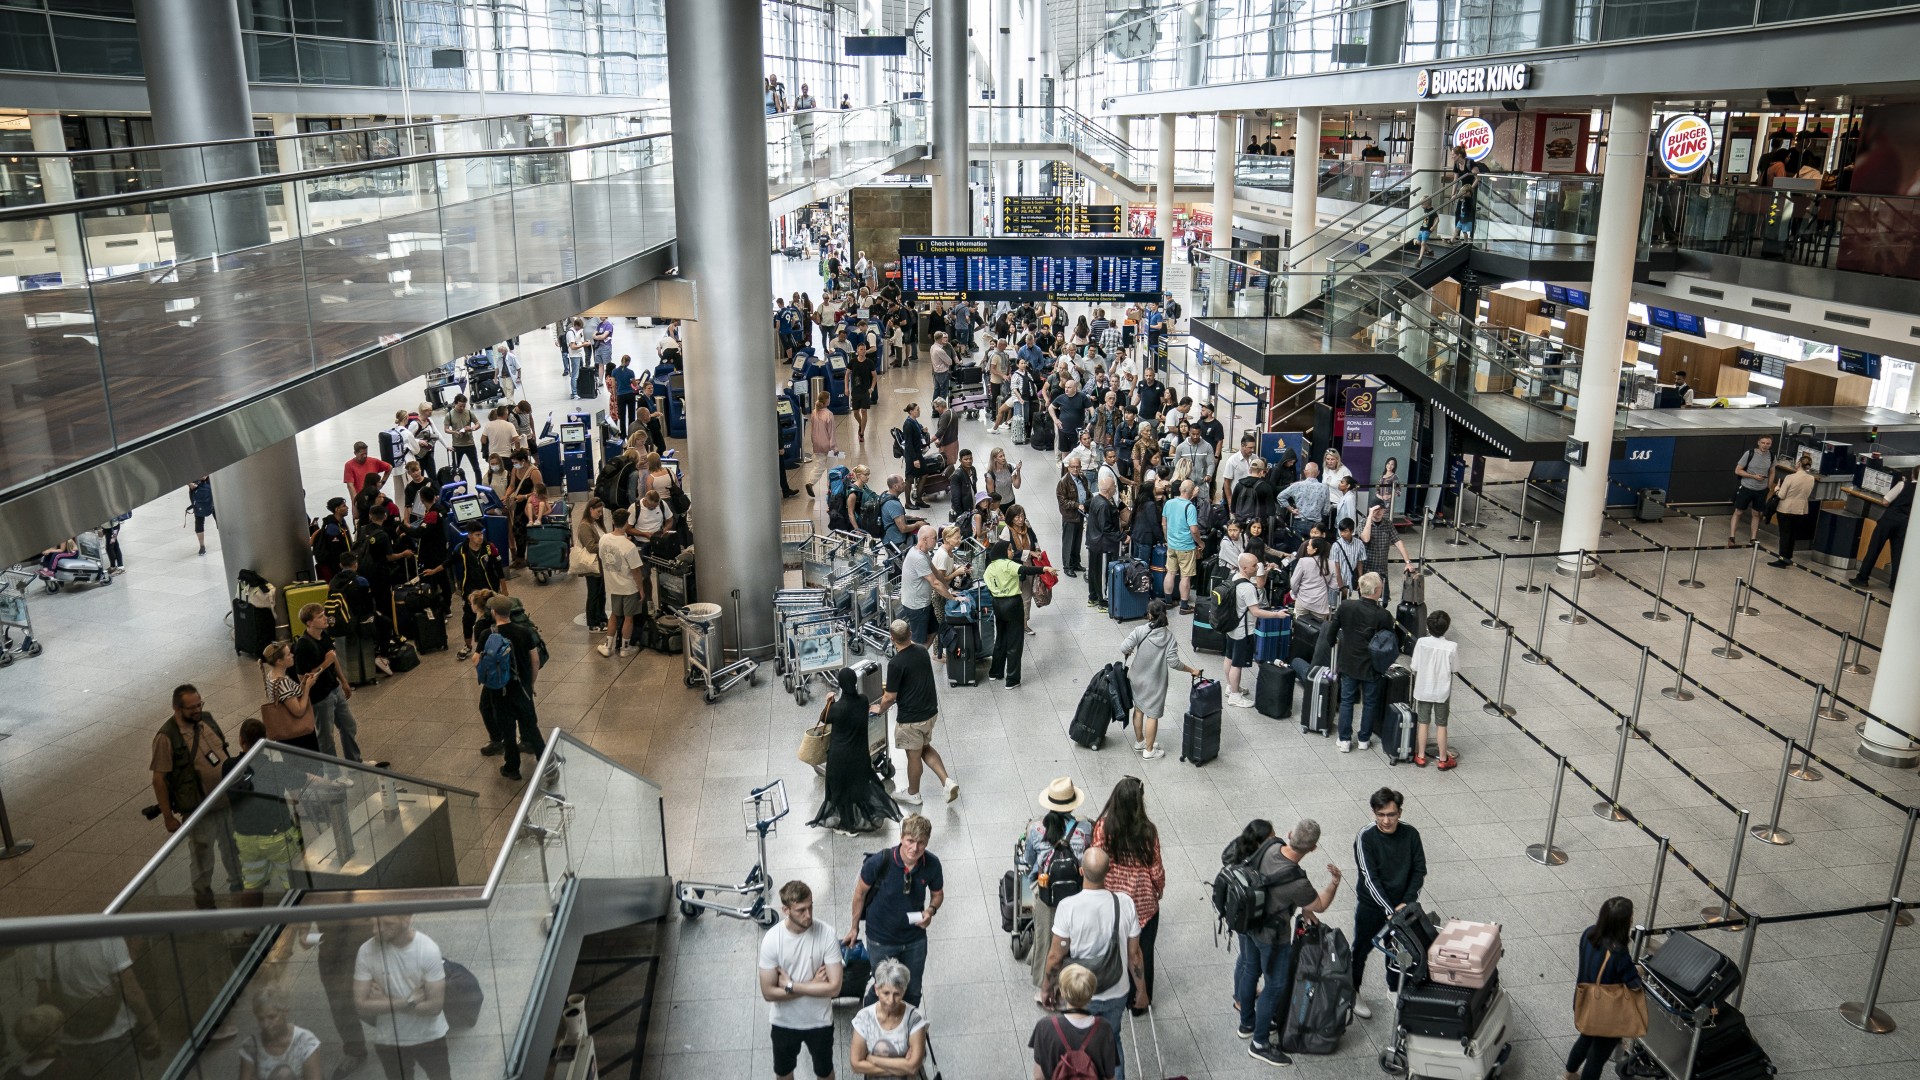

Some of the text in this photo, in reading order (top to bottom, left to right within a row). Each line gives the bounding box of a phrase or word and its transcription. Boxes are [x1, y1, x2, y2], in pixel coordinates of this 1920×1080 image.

[1432, 63, 1526, 94] BURGER KING
[1458, 126, 1489, 141] BURGER
[1668, 128, 1707, 146] BURGER
[1460, 134, 1490, 150] KING
[1667, 137, 1708, 160] KING
[785, 314, 791, 324] 9
[1739, 358, 1750, 366] SAS
[1630, 450, 1653, 460] SAS
